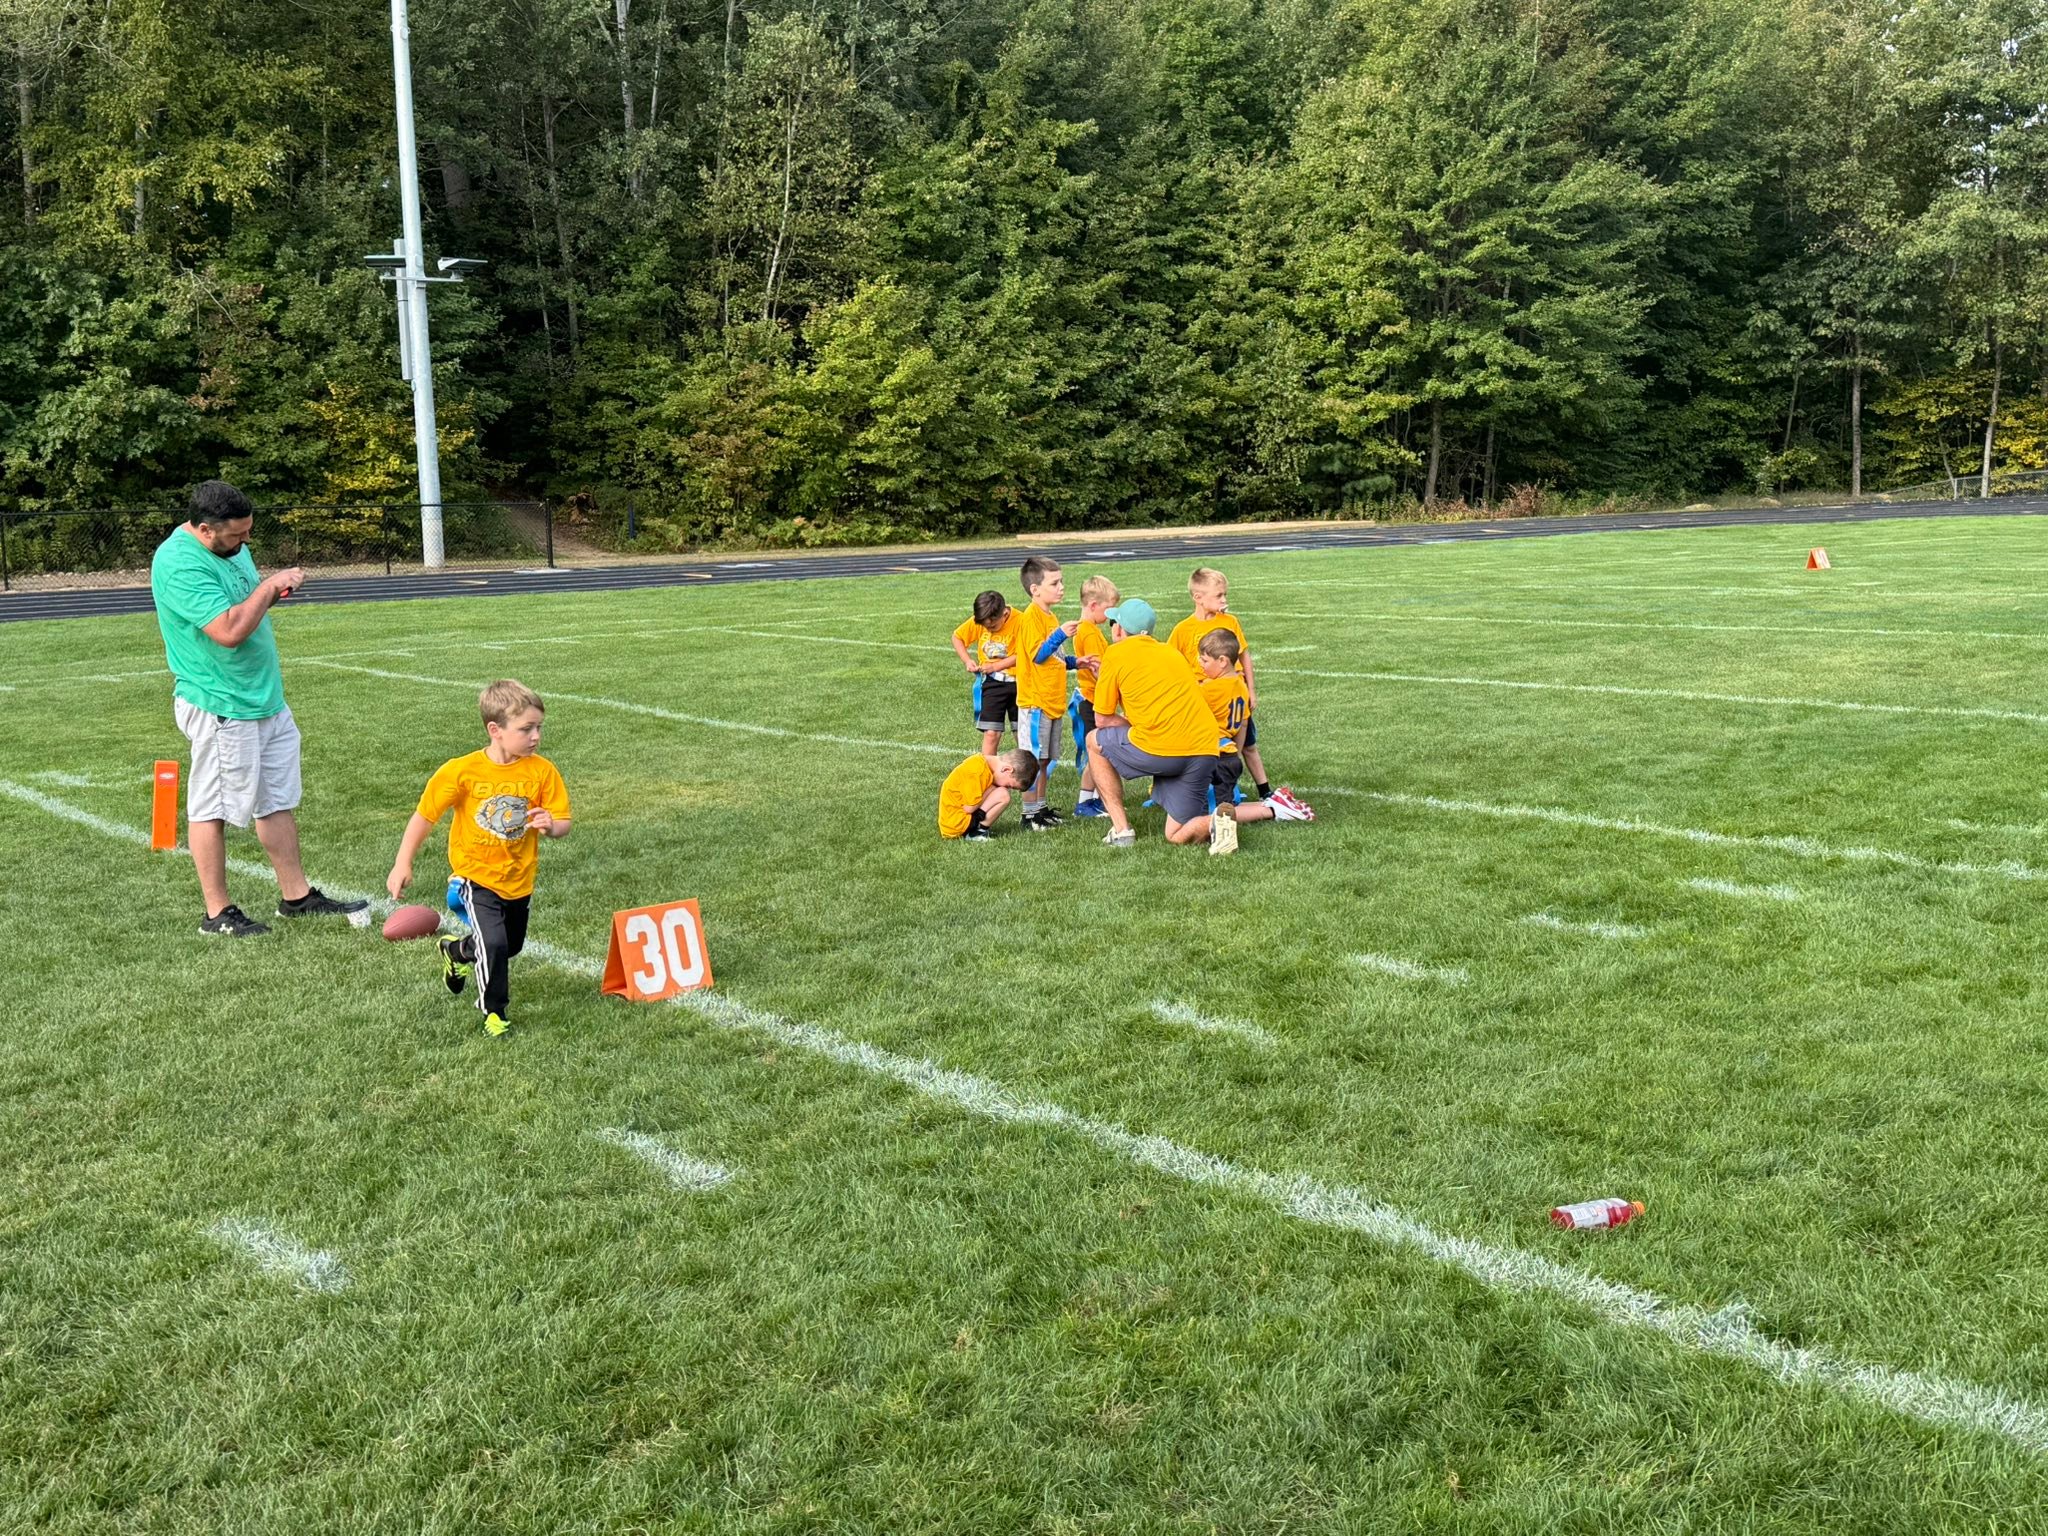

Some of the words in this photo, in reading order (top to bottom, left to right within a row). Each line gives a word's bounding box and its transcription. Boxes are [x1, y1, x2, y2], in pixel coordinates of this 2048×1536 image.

[1226, 696, 1245, 730] 10
[472, 781, 540, 799] BOW
[625, 907, 704, 995] 30
